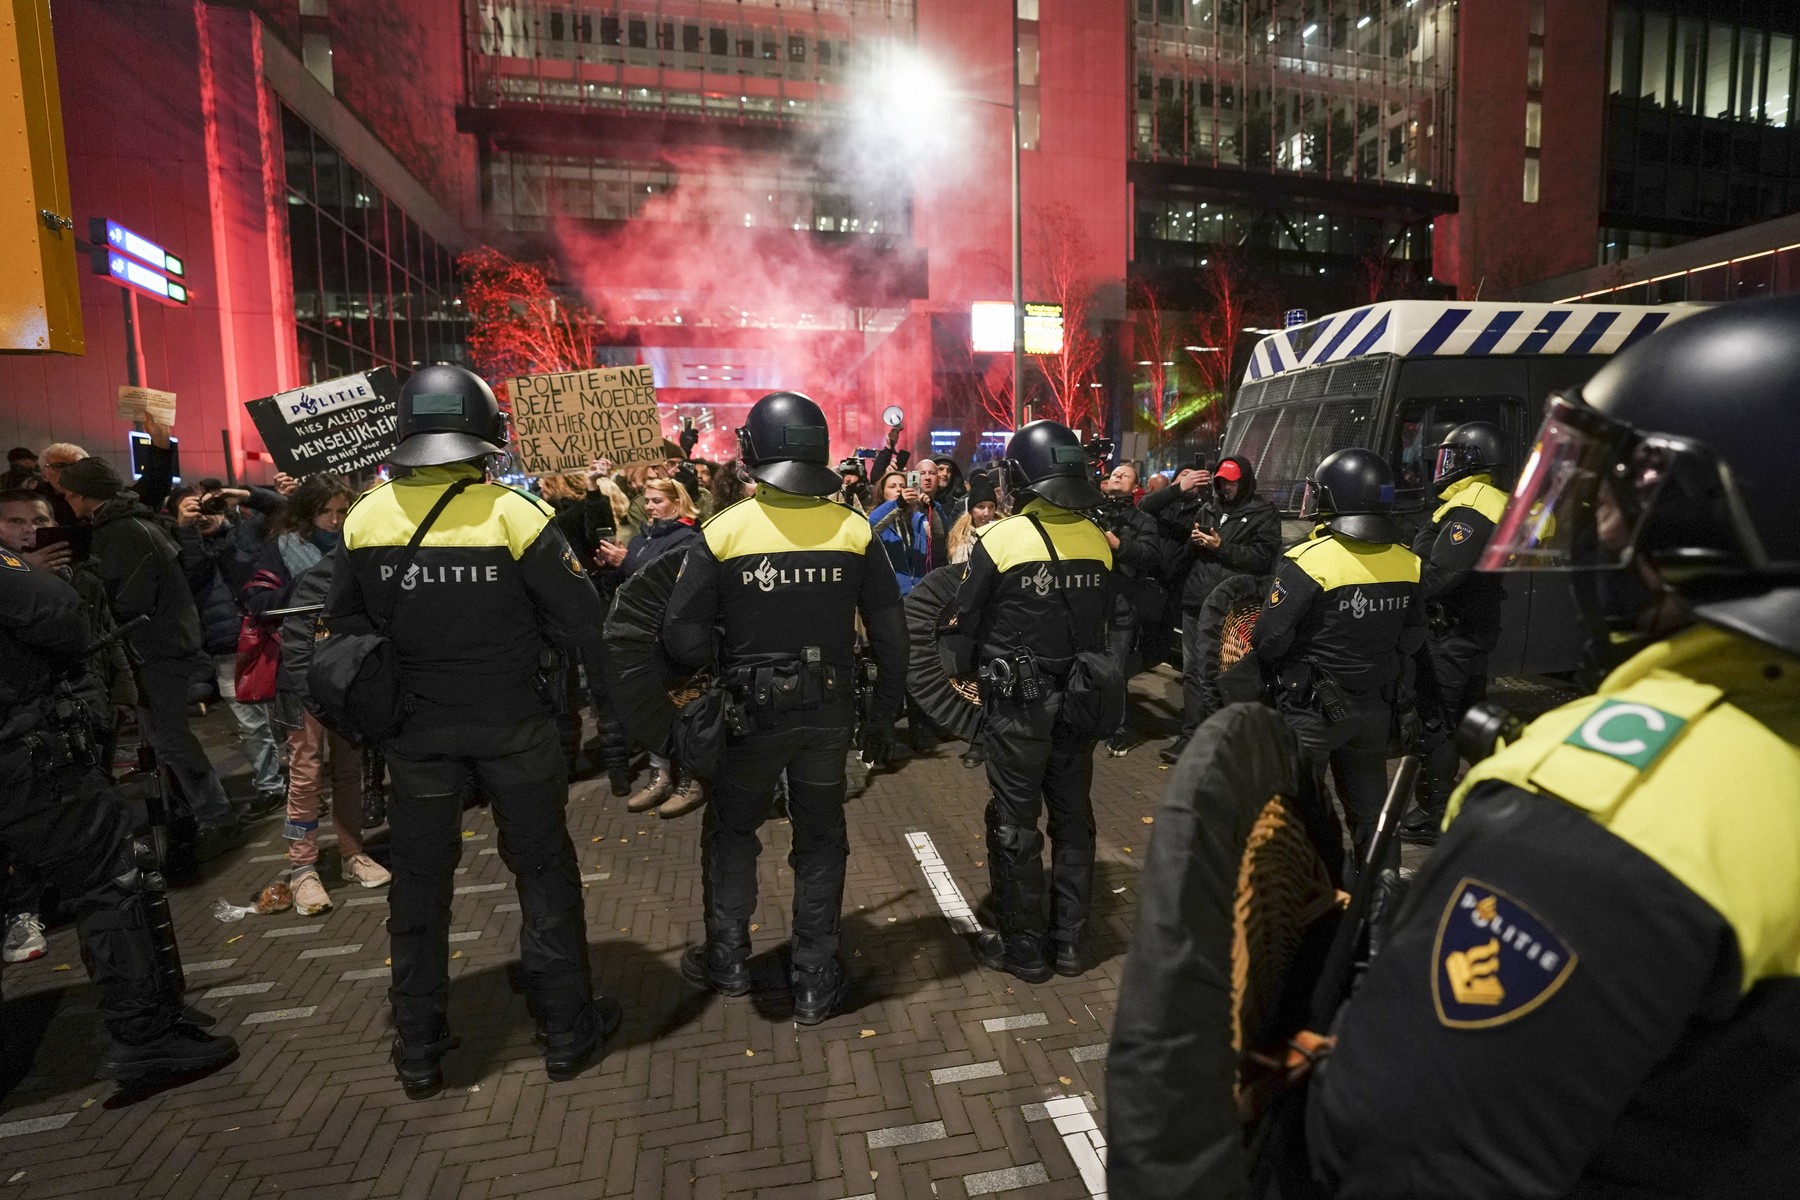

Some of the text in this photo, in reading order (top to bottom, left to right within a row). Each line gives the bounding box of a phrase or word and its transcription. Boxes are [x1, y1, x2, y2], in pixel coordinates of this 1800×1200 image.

[516, 368, 654, 396] POLITIE EN ME
[515, 386, 657, 417] DEZE MOEDER
[516, 415, 553, 437] STAAT
[591, 409, 620, 431] OOK
[617, 408, 659, 429] VOOR
[326, 453, 340, 464] EN
[520, 437, 543, 458] DE
[522, 457, 551, 473] VAN
[380, 562, 498, 590] POLITIE
[742, 563, 842, 591] POLITIE
[1021, 568, 1100, 595] POLITIE
[1339, 592, 1410, 618] POLITIE
[1580, 702, 1666, 756] C
[1460, 891, 1560, 971] POLITIE
